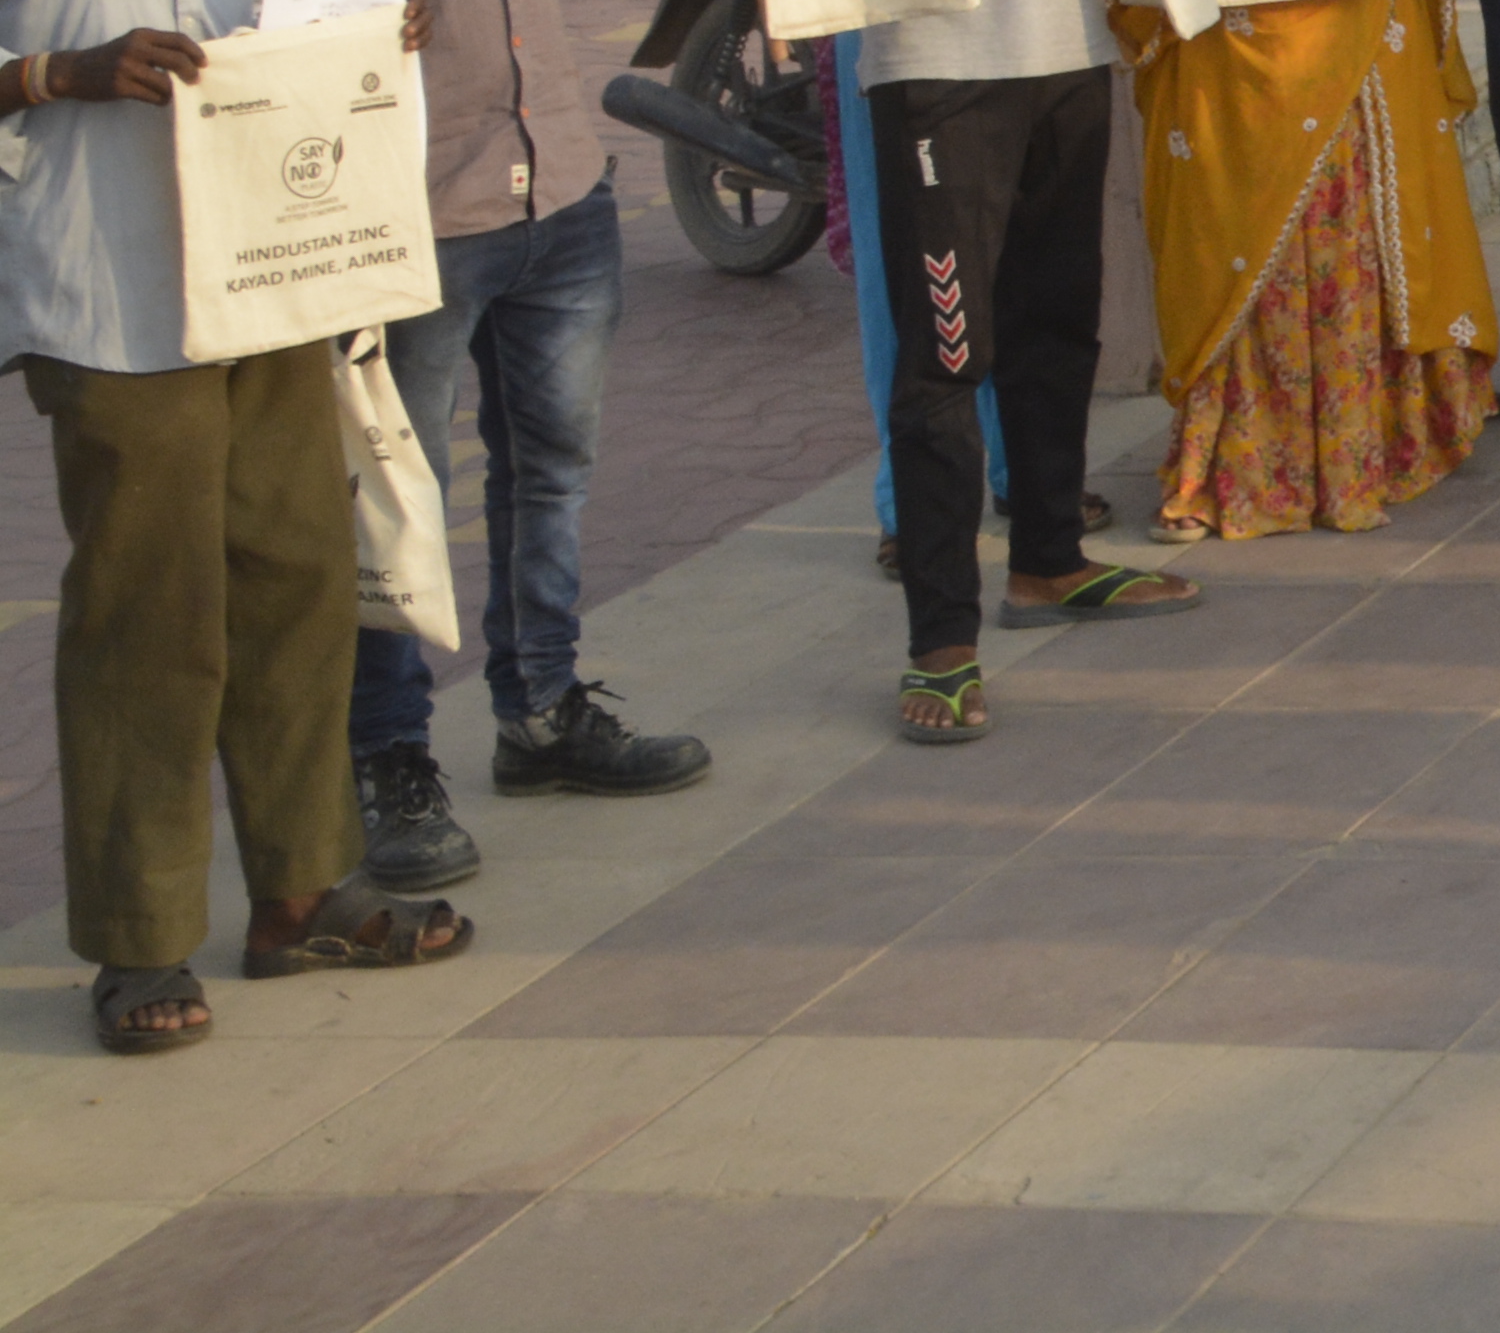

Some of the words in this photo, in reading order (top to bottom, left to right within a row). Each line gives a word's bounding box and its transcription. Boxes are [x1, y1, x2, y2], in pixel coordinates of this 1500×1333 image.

[218, 98, 271, 113] vedanta
[299, 144, 326, 161] SAY
[236, 233, 343, 265] HINDUSTAN
[348, 224, 390, 244] ZINC
[226, 271, 284, 294] KAYAD
[291, 260, 342, 282] MINE,
[347, 246, 408, 270] AJMER
